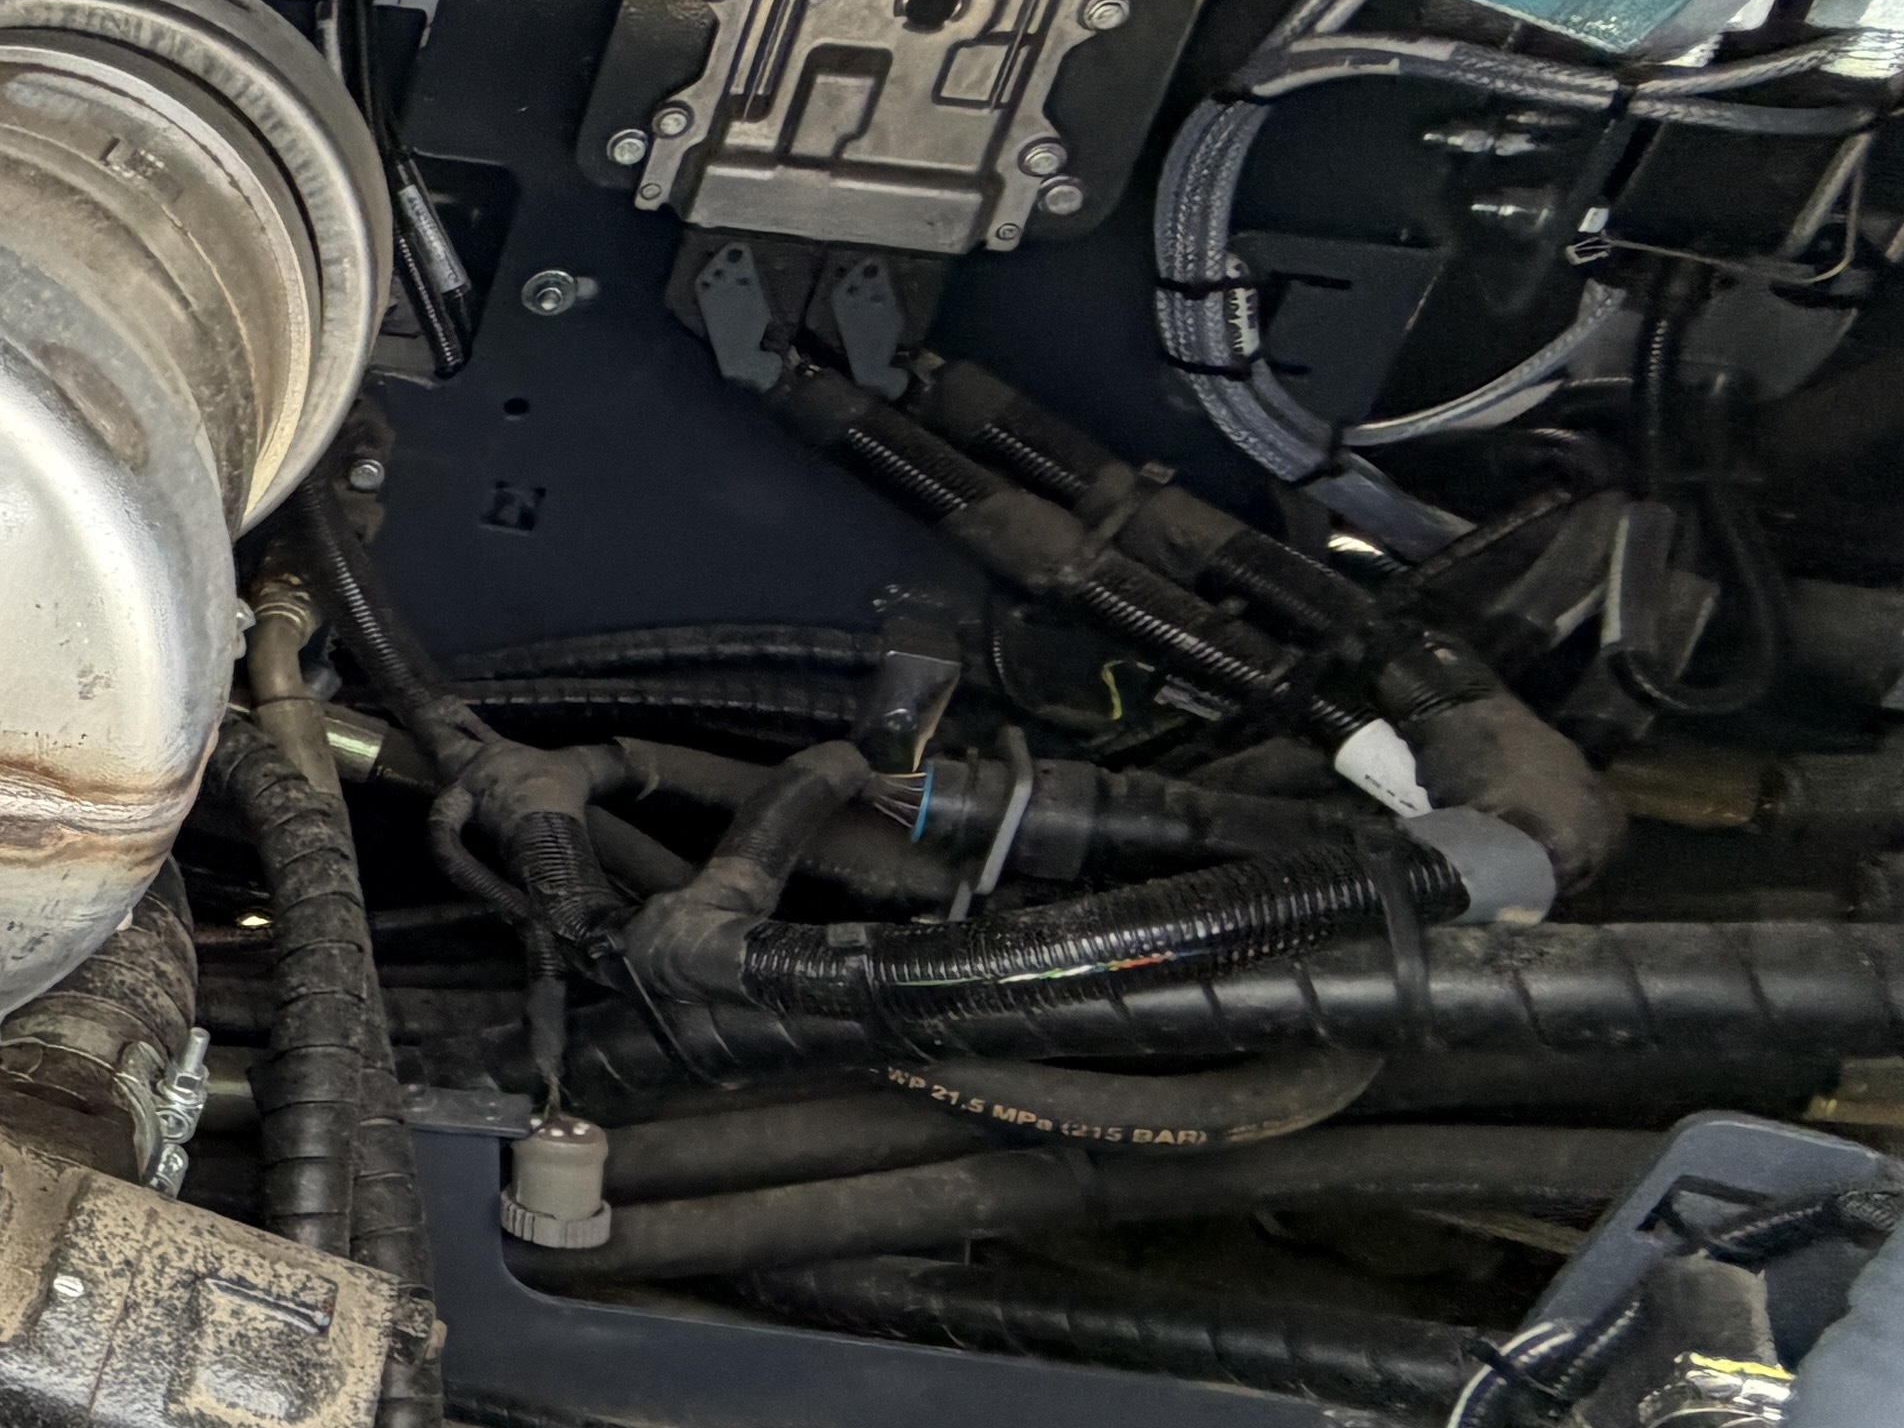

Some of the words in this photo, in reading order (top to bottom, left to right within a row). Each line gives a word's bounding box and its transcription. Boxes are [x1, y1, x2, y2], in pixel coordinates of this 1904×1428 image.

[888, 1066, 927, 1090] WP
[931, 1084, 985, 1114] 21.5
[992, 1103, 1053, 1131] MPa
[1132, 1128, 1209, 1145] BAR)
